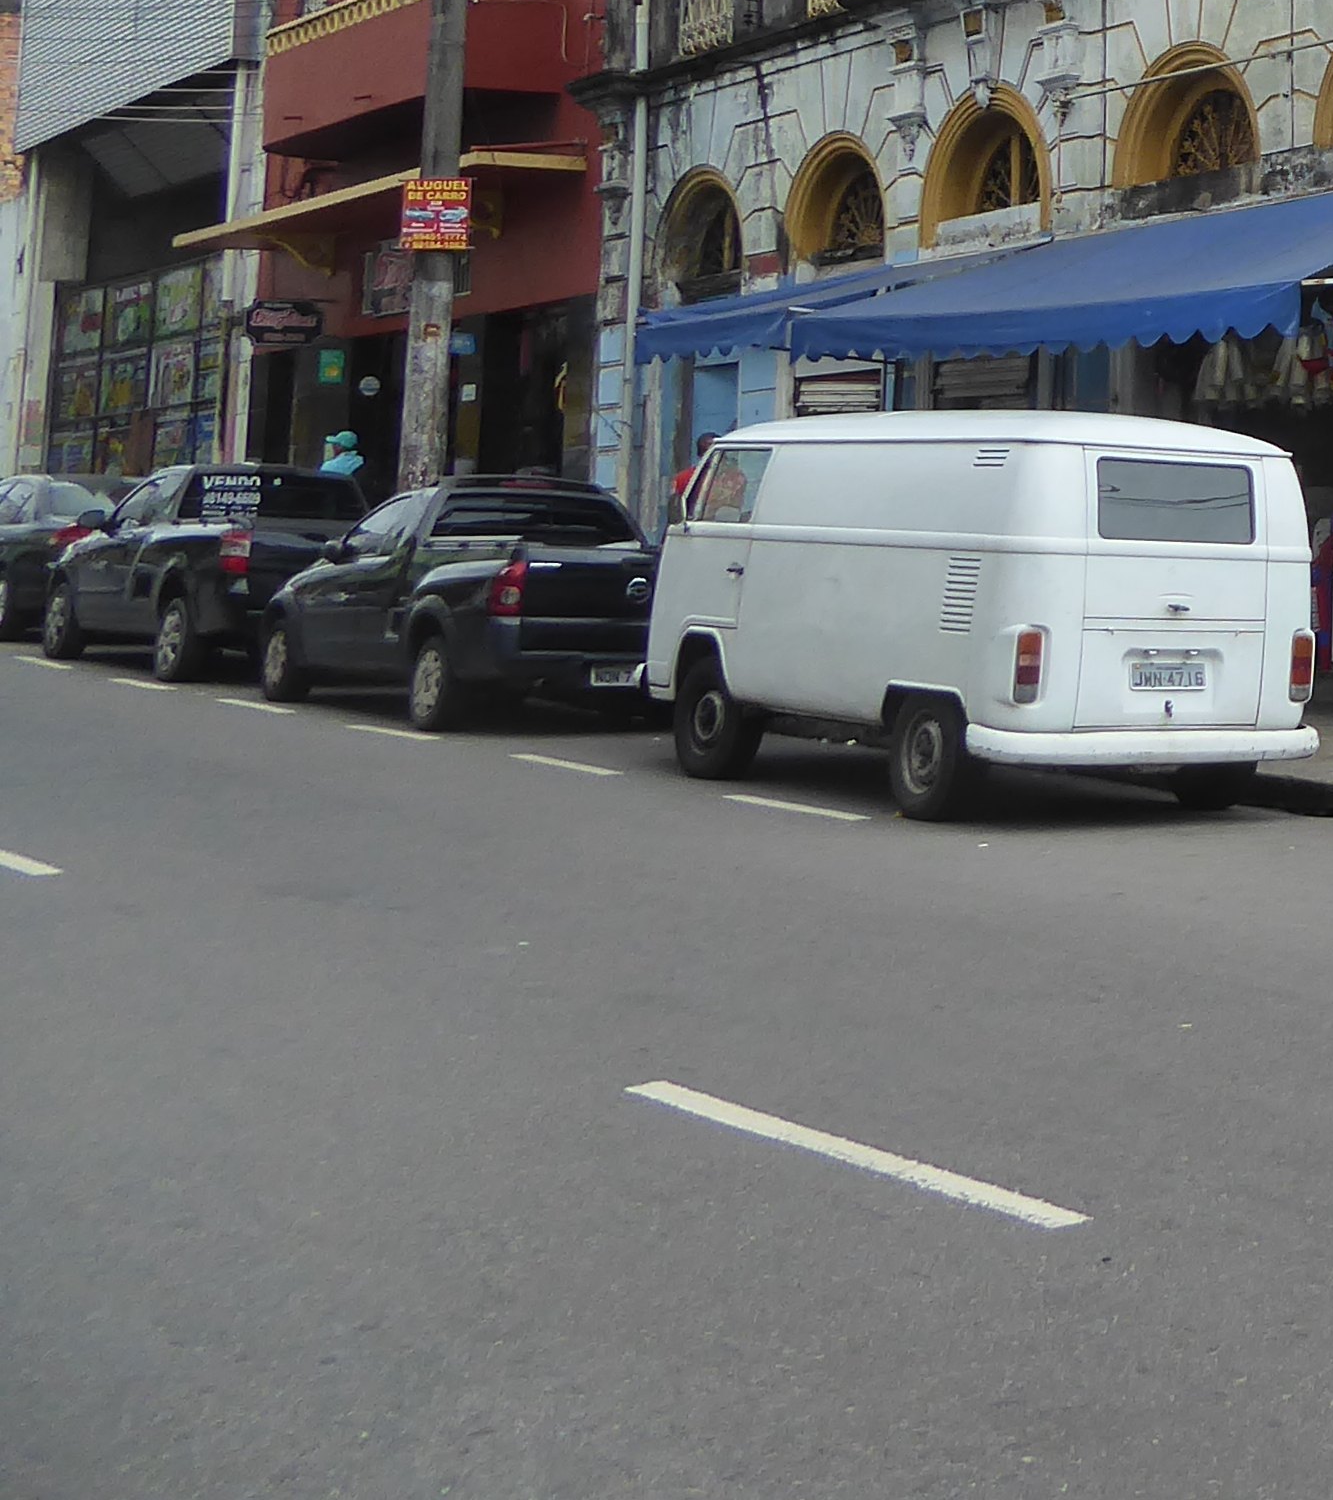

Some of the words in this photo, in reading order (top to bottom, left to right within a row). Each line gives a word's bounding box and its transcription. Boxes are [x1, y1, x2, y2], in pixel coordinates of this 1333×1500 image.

[407, 181, 468, 190] ALUGUEL
[408, 191, 423, 200] DE
[426, 191, 467, 200] CARRO
